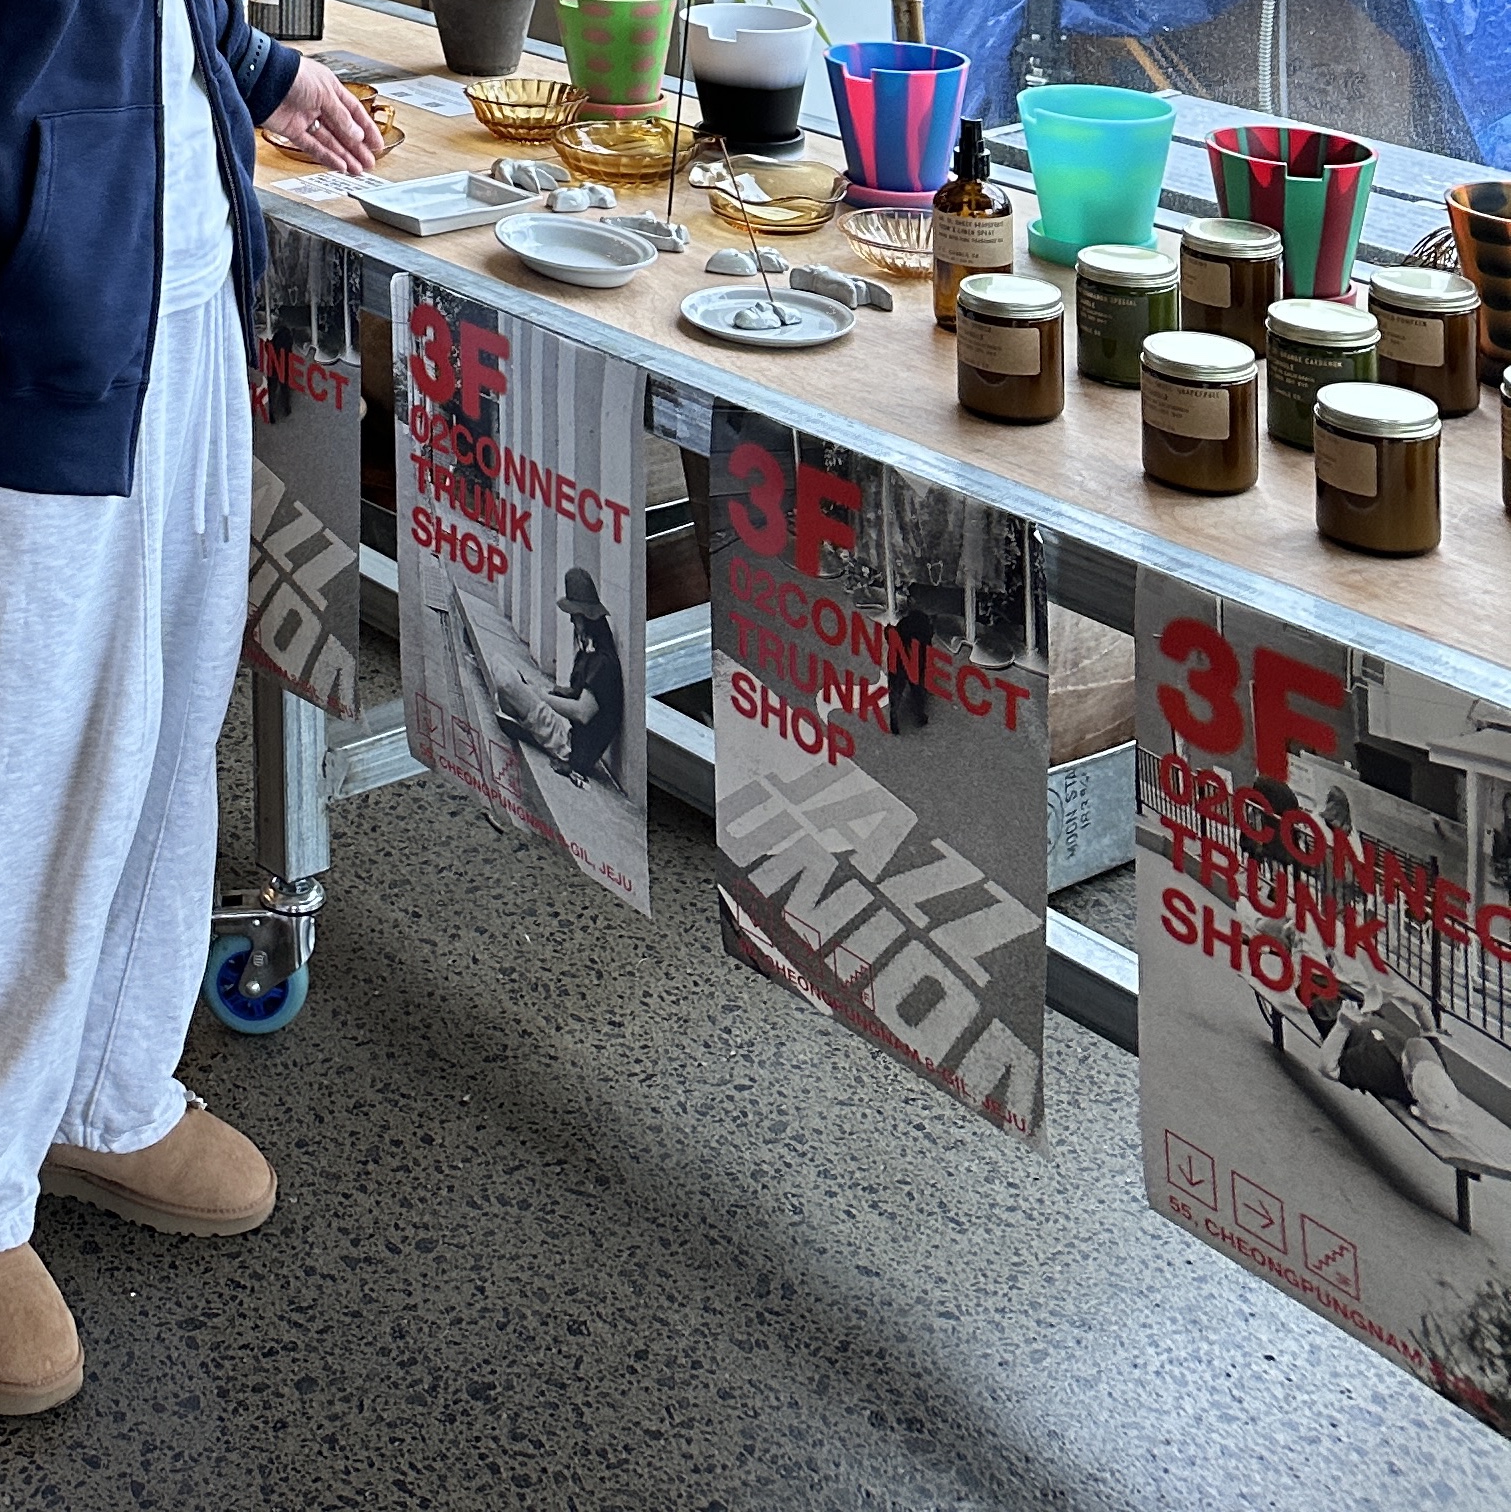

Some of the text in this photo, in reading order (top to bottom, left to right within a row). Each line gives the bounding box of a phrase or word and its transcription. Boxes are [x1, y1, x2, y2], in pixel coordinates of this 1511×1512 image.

[258, 338, 350, 413] NECT
[408, 303, 510, 422] 3F
[410, 452, 533, 553] TRUNK
[411, 506, 509, 583] SHOP
[728, 443, 862, 577] 3F
[729, 610, 891, 735] TRUNK
[730, 670, 856, 766] SHOP
[1157, 617, 1347, 783] 3F
[599, 861, 633, 893] JEJU
[1160, 814, 1388, 975] TRUNK
[1161, 887, 1340, 1009] SHOP
[1168, 1194, 1424, 1366] 55, CHEONGPUNGNAM
